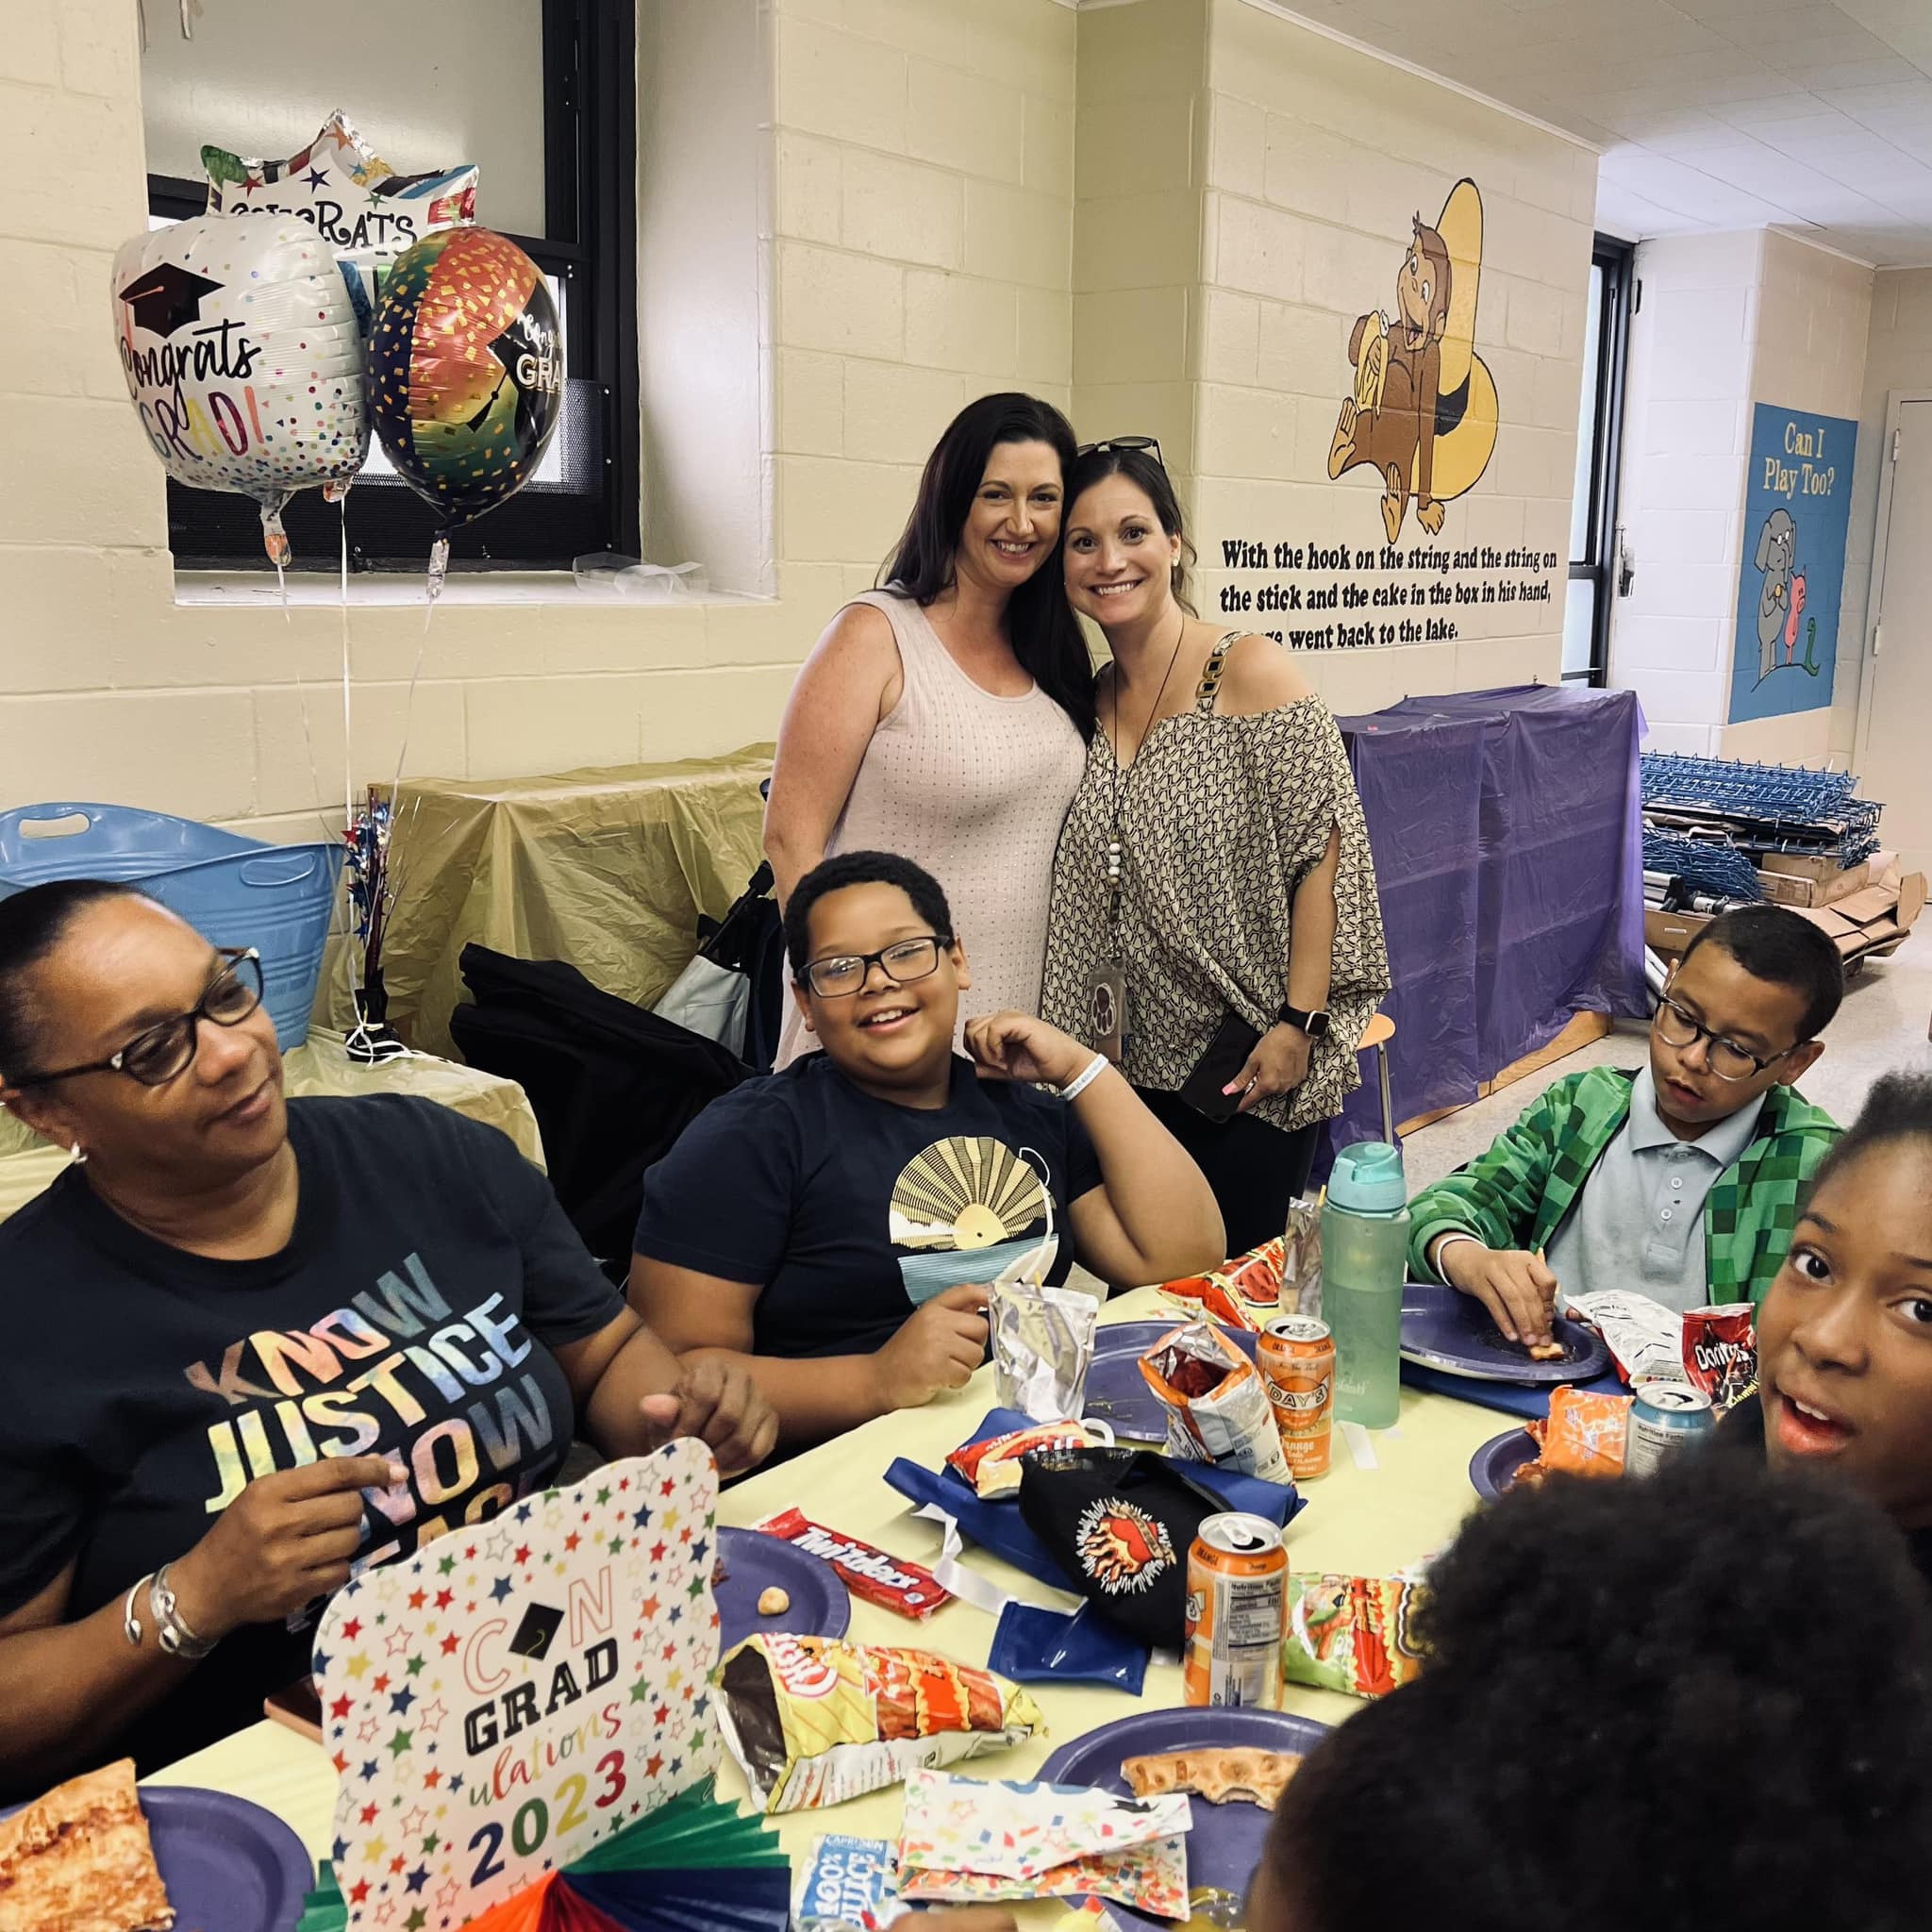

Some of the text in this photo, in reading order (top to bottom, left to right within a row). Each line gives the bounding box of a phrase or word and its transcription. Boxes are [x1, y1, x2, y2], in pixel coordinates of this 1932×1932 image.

[120, 318, 261, 430] Congrats
[1785, 422, 1824, 458] Can I
[1763, 457, 1835, 500] Play Too?
[1223, 540, 1557, 575] With the hook on the string and the string on
[1220, 579, 1551, 613] the stick and the cake in the box in his hand,
[1289, 624, 1334, 650] went
[1337, 621, 1375, 649] back
[1379, 622, 1395, 644] to
[1399, 618, 1423, 643] the
[1425, 617, 1458, 641] lake.
[184, 1253, 453, 1407] KNOW
[1694, 1341, 1751, 1371] Doritos
[205, 1291, 532, 1514] JUSTICE
[1269, 1384, 1325, 1407] DAY'S
[464, 1637, 619, 1757] GRAD
[469, 1702, 622, 1806] ulations
[467, 1749, 626, 1889] 2023
[814, 1852, 844, 1917] 100%
